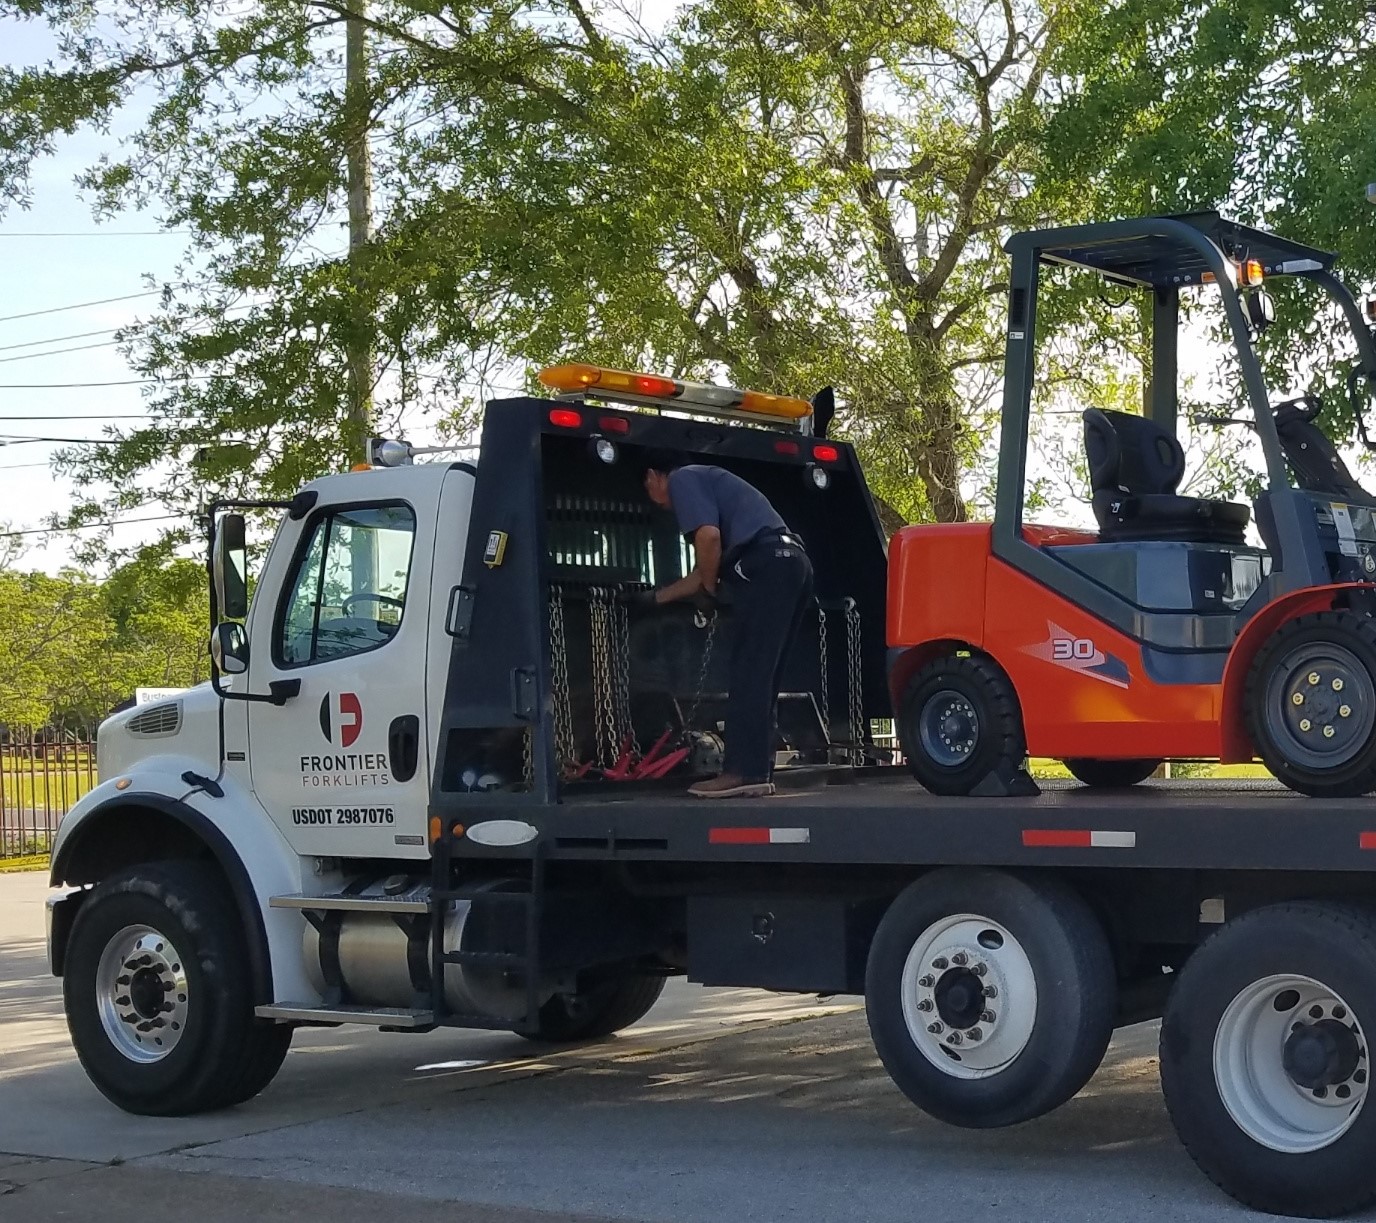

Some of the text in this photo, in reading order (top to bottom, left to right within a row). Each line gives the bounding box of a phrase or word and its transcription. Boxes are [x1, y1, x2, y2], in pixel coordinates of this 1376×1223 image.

[1053, 638, 1095, 660] 30
[301, 754, 388, 772] FRONTIER
[303, 774, 389, 787] FORKLIFTS
[292, 808, 394, 824] USDOT 2987076
